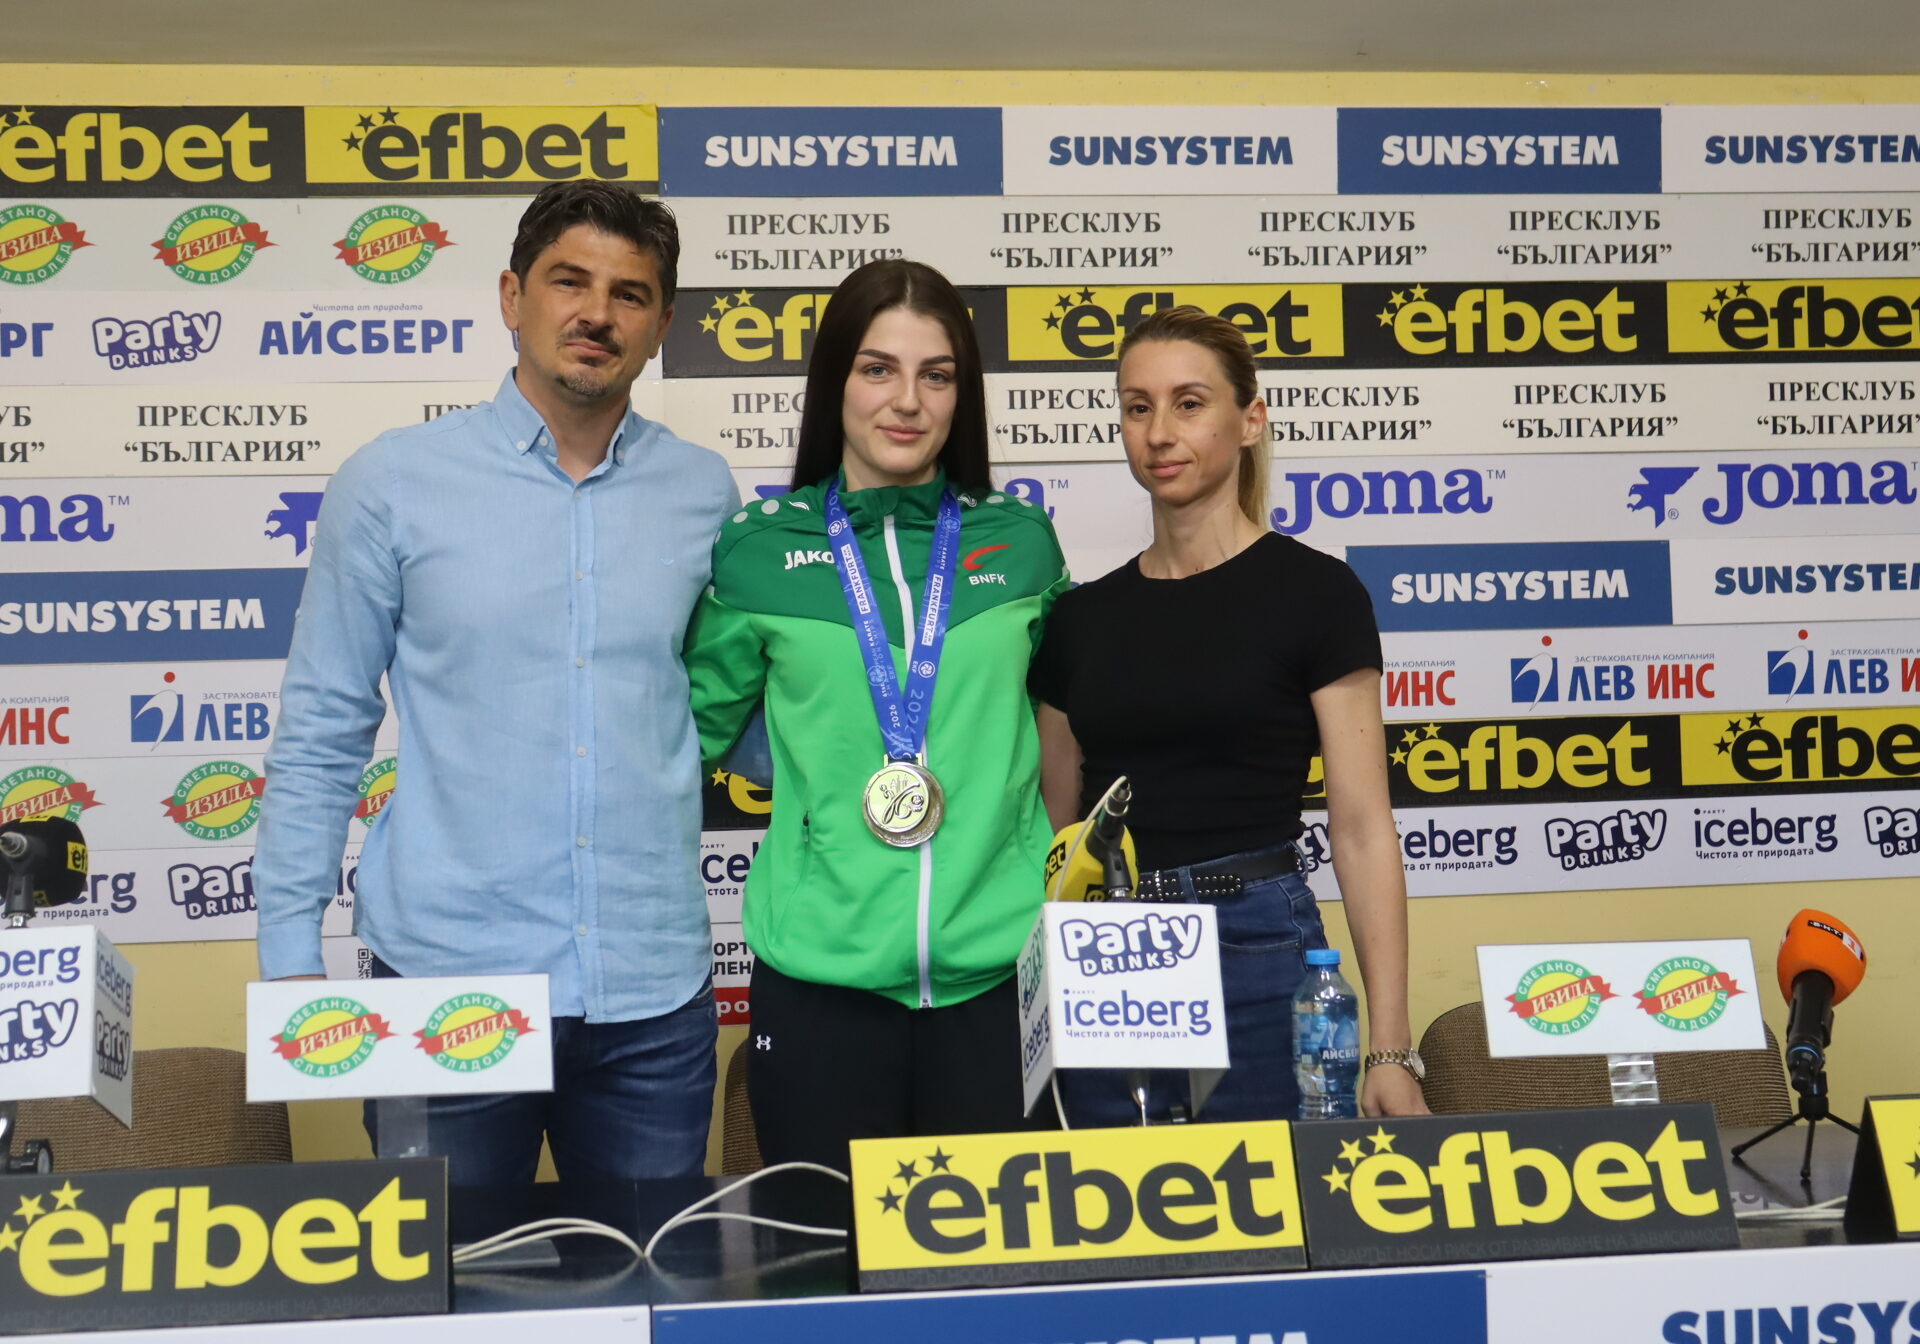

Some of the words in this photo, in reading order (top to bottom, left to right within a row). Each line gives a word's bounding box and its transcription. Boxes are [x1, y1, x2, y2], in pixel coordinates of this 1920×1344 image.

[0, 111, 271, 183] efbet
[361, 110, 629, 182] efbet
[704, 134, 958, 167] SUNSYSTEM
[1048, 135, 1294, 166] SUNSYSTEM
[1381, 134, 1620, 167] SUNSYSTEM
[0, 207, 58, 225] ЕТАНОВ
[167, 207, 241, 241] СМЕТАНОВ
[349, 207, 421, 241] СМЕТАНОВ
[727, 212, 891, 236] ПРЕСКЛУБ
[1001, 211, 1162, 234] ПРЕСКЛУБ
[1259, 210, 1416, 232] ПРЕСКЛУБ
[1508, 209, 1661, 232] ПРЕСКЛУБ
[1763, 207, 1913, 230] ПРЕСКЛУБ
[175, 225, 247, 262] ИЗИДА
[356, 225, 427, 262] ИЗИДА
[1, 243, 73, 285] ЛАДОЛЕД
[176, 243, 256, 284] СЛАДОЛЕД
[356, 243, 435, 284] СЛАДОЛЕД
[93, 311, 221, 355] Party
[259, 311, 474, 355] АЙСБЕРГ
[1393, 286, 1637, 355] efbet
[1717, 286, 1920, 350] efbe
[111, 345, 196, 369] DRINKS
[1008, 388, 1120, 411] ПРЕСКЛ
[1265, 386, 1420, 408] ПРЕСКЛУБ
[1513, 382, 1667, 405] ПРЕСКЛУБ
[1768, 380, 1916, 402] ПРЕСКЛУБ
[137, 405, 308, 427] ПРЕСКЛУБ
[995, 422, 1120, 445] “БЪЛГАР
[1271, 420, 1432, 442] БЪЛГАРИЯ”
[1270, 468, 1494, 535] Joma
[1702, 460, 1918, 525] Joma
[0, 493, 115, 542] ma
[784, 549, 835, 570] JAKO
[845, 556, 869, 612] FRANKFURT
[968, 573, 1007, 586] BNFK
[1391, 568, 1629, 604] SUNSYSTEM
[0, 598, 266, 635] SUNSYSTEM
[926, 576, 942, 634] FRANKFURT
[1402, 660, 1456, 668] КОМПАНИЯ
[1574, 654, 1661, 664] ЗАСТРАХОВАТЕЛНА
[1662, 652, 1715, 661] КОМПАНИЯ
[1830, 648, 1915, 656] ЗАСТРАХОВАТЕЛНА
[1386, 669, 1456, 707] ИНС
[1567, 665, 1636, 702] ЛЕВ
[1647, 662, 1715, 700] ИНС
[1823, 658, 1890, 694] ЛЕВ
[9, 695, 70, 705] КОМПАНИЯ
[202, 691, 281, 701] ЗАСТРАХОВАТЕ
[194, 702, 271, 742] ЛЕВ
[888, 704, 901, 728] 2026
[1406, 720, 1651, 793] efbet
[1731, 715, 1920, 782] efbe
[0, 768, 67, 797] МЕТАНОВ
[177, 763, 250, 798] СМЕТАНОВ
[1, 785, 73, 824] ИЗИДА
[185, 781, 256, 820] ИЗИДА
[1404, 819, 1518, 866] eberg
[1545, 809, 1667, 857] Party
[1694, 808, 1839, 853] iceberg
[1419, 862, 1431, 871] от
[1435, 860, 1493, 873] природата
[1562, 843, 1645, 870] DRINKS
[1695, 850, 1739, 860] Чистота
[1742, 850, 1753, 858] от
[1757, 847, 1814, 860] природата
[187, 894, 258, 919] DRINK
[707, 887, 739, 896] стота
[43, 907, 109, 920] природата
[1060, 913, 1202, 961] Party
[1081, 951, 1178, 976] DRINKS
[1518, 963, 1583, 995] СМЕТАНОВ
[1646, 960, 1710, 992] СМЕТАНОВ
[0, 979, 54, 990] риродата
[1531, 979, 1596, 1016] ИЗИДА
[1659, 976, 1723, 1012] ИЗИДА
[0, 999, 79, 1047] rty
[286, 998, 363, 1035] СМЕТАНОВ
[428, 994, 502, 1031] СМЕТАНОВ
[1063, 988, 1212, 1036] iceberg
[1529, 994, 1601, 1034] СЛАДОЛЕД
[1656, 991, 1728, 1031] СЛАДОЛЕД
[299, 1017, 373, 1056] ИЗИДА
[441, 1011, 513, 1051] ИЗИДА
[1065, 1029, 1110, 1039] Чистота
[1129, 1030, 1188, 1040] природата
[294, 1032, 378, 1076] СЛАДОЛЕД
[436, 1029, 518, 1072] СЛАДОЛЕД
[1350, 1119, 1720, 1234] efbet
[904, 1139, 1285, 1254] efbet
[18, 1176, 430, 1297] efbet
[1662, 1301, 1920, 1344] SUNSY
